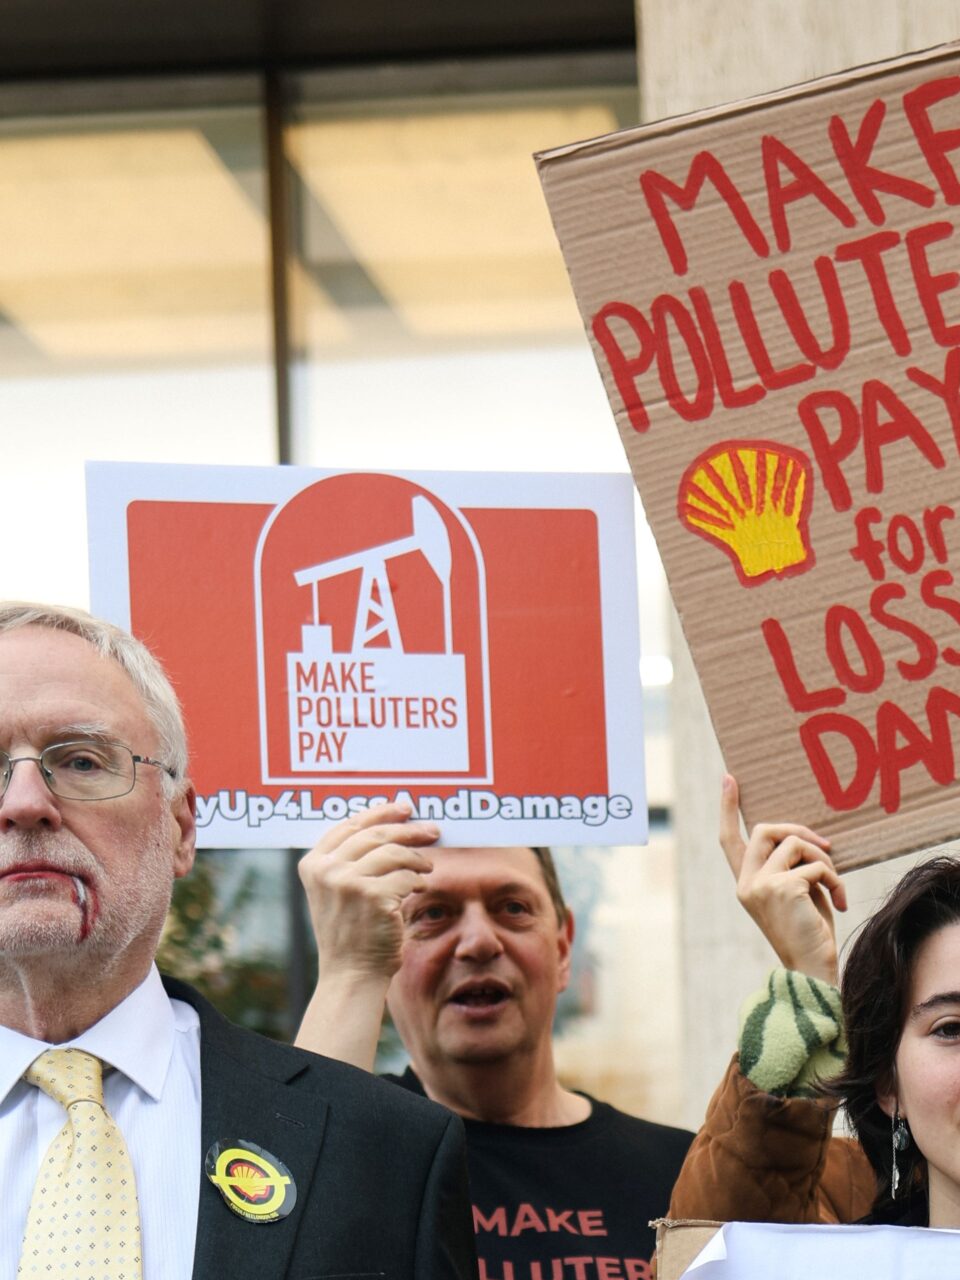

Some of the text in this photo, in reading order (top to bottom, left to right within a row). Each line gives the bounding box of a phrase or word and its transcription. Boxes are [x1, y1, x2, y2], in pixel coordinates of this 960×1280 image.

[850, 504, 956, 583] for
[295, 661, 376, 693] MAKE
[297, 696, 458, 729] POLLUTERS
[298, 731, 348, 763] PAY
[471, 1203, 609, 1237] MAKE
